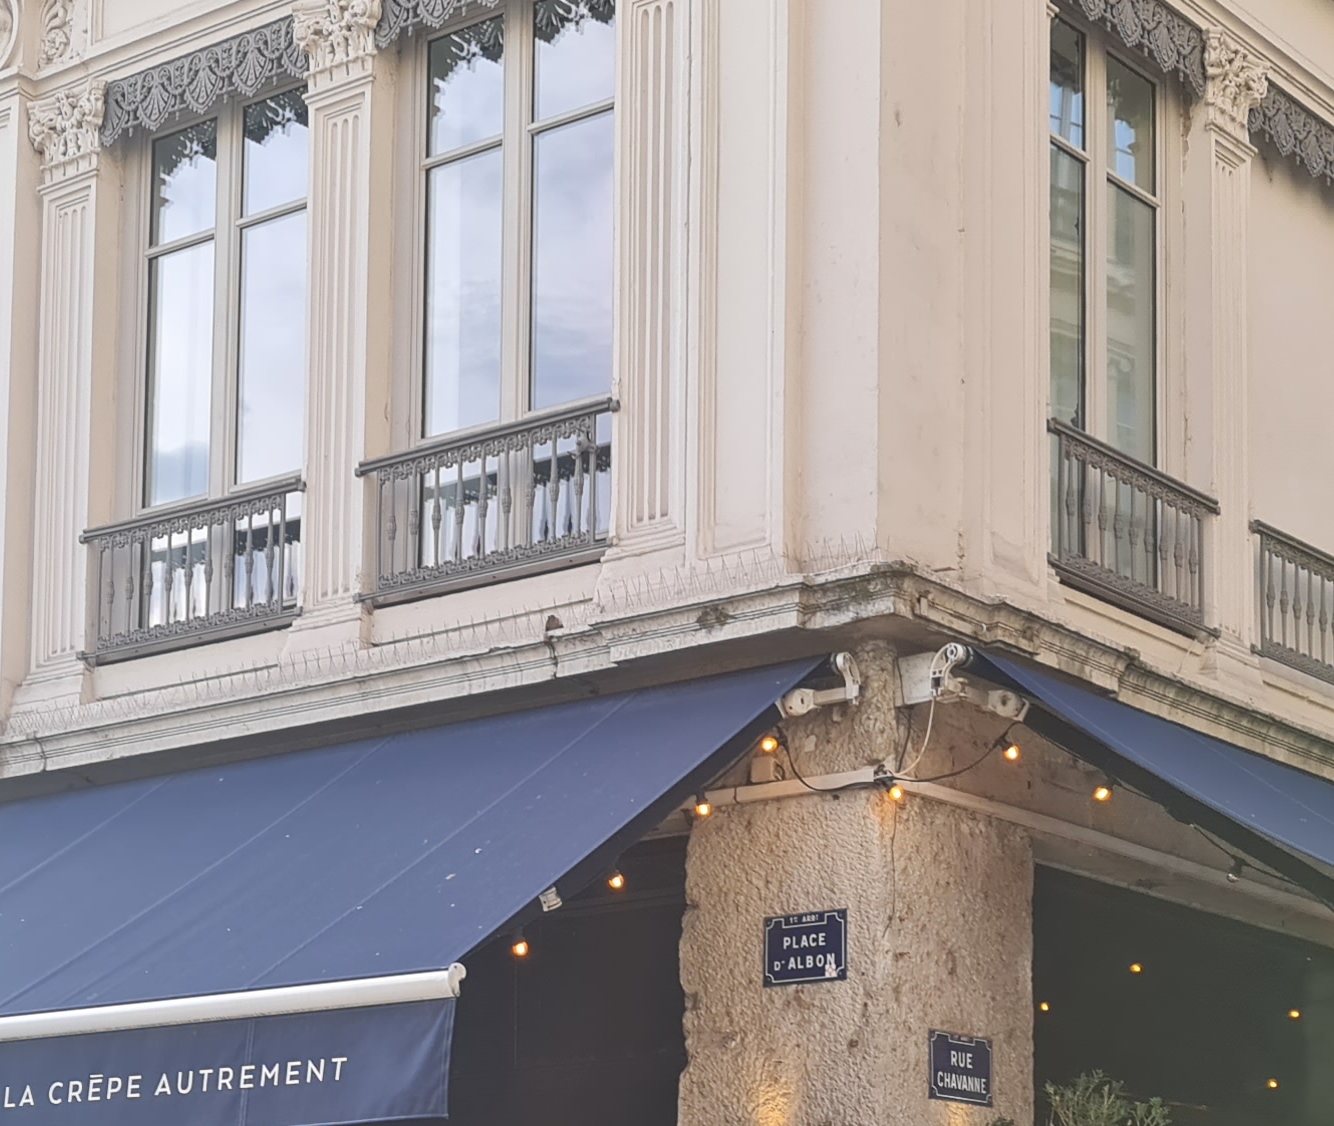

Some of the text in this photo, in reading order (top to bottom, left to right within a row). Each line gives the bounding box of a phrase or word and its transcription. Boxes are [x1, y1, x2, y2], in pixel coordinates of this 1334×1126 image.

[783, 932, 826, 950] PLACE
[950, 1050, 973, 1069] RUE
[3, 1084, 35, 1108] LA
[154, 1056, 348, 1097] AUTREMENT
[937, 1071, 987, 1095] CHAVANNE
